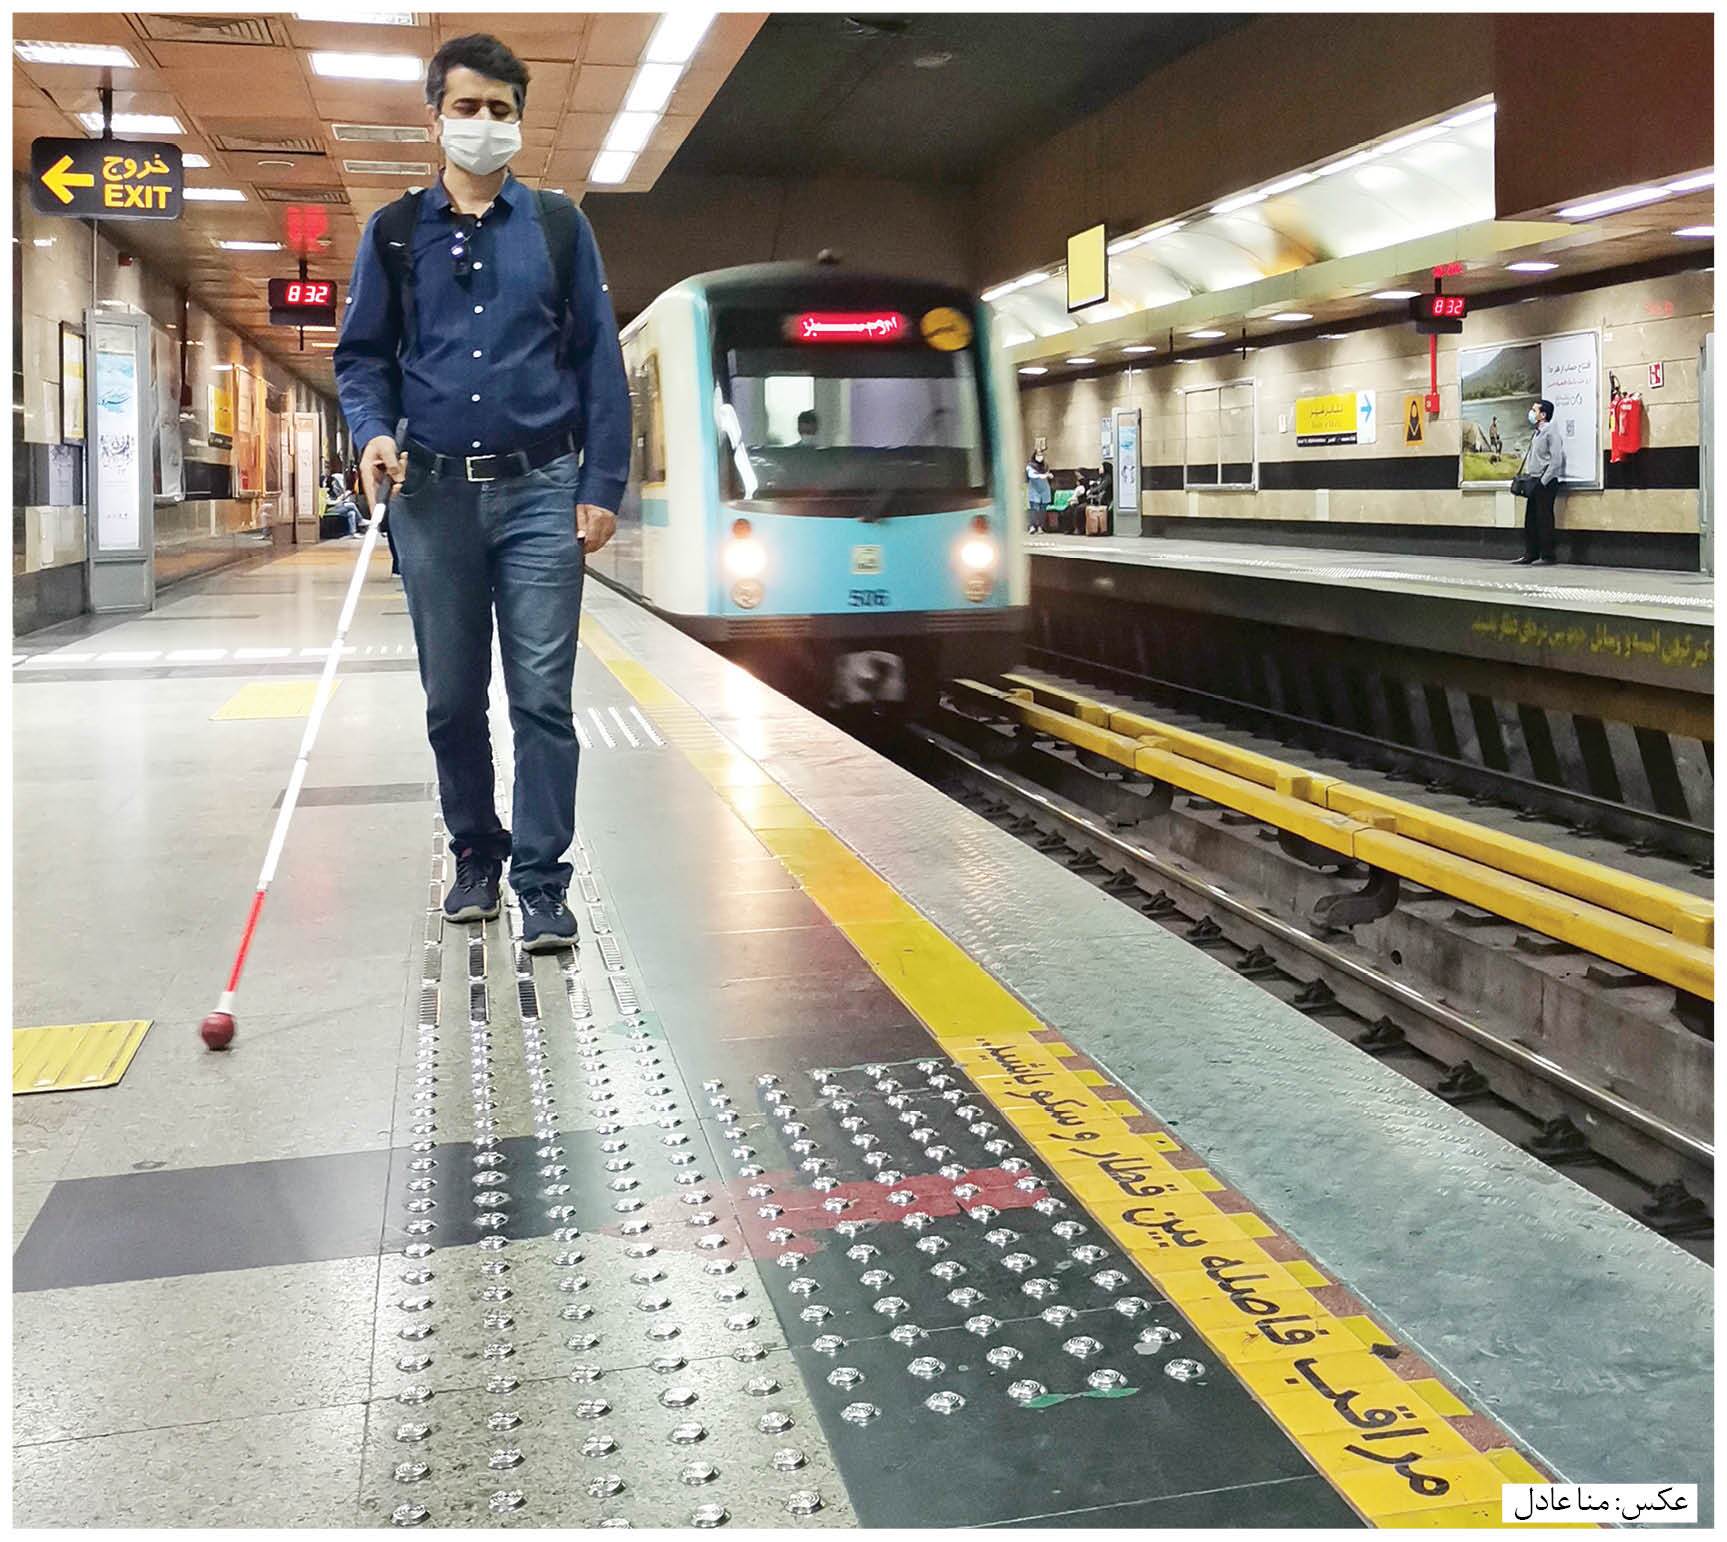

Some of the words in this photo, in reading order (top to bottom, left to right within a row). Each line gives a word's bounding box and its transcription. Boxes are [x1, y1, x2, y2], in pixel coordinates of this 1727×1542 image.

[102, 154, 170, 181] خروج
[104, 183, 172, 209] EXIT
[1004, 1089, 1089, 1127] سکو
[1047, 1130, 1101, 1142] و
[1069, 1147, 1180, 1197] قطار
[1122, 1207, 1208, 1248] بین
[1200, 1255, 1330, 1346] فاصله
[1284, 1357, 1450, 1497] مراقب
